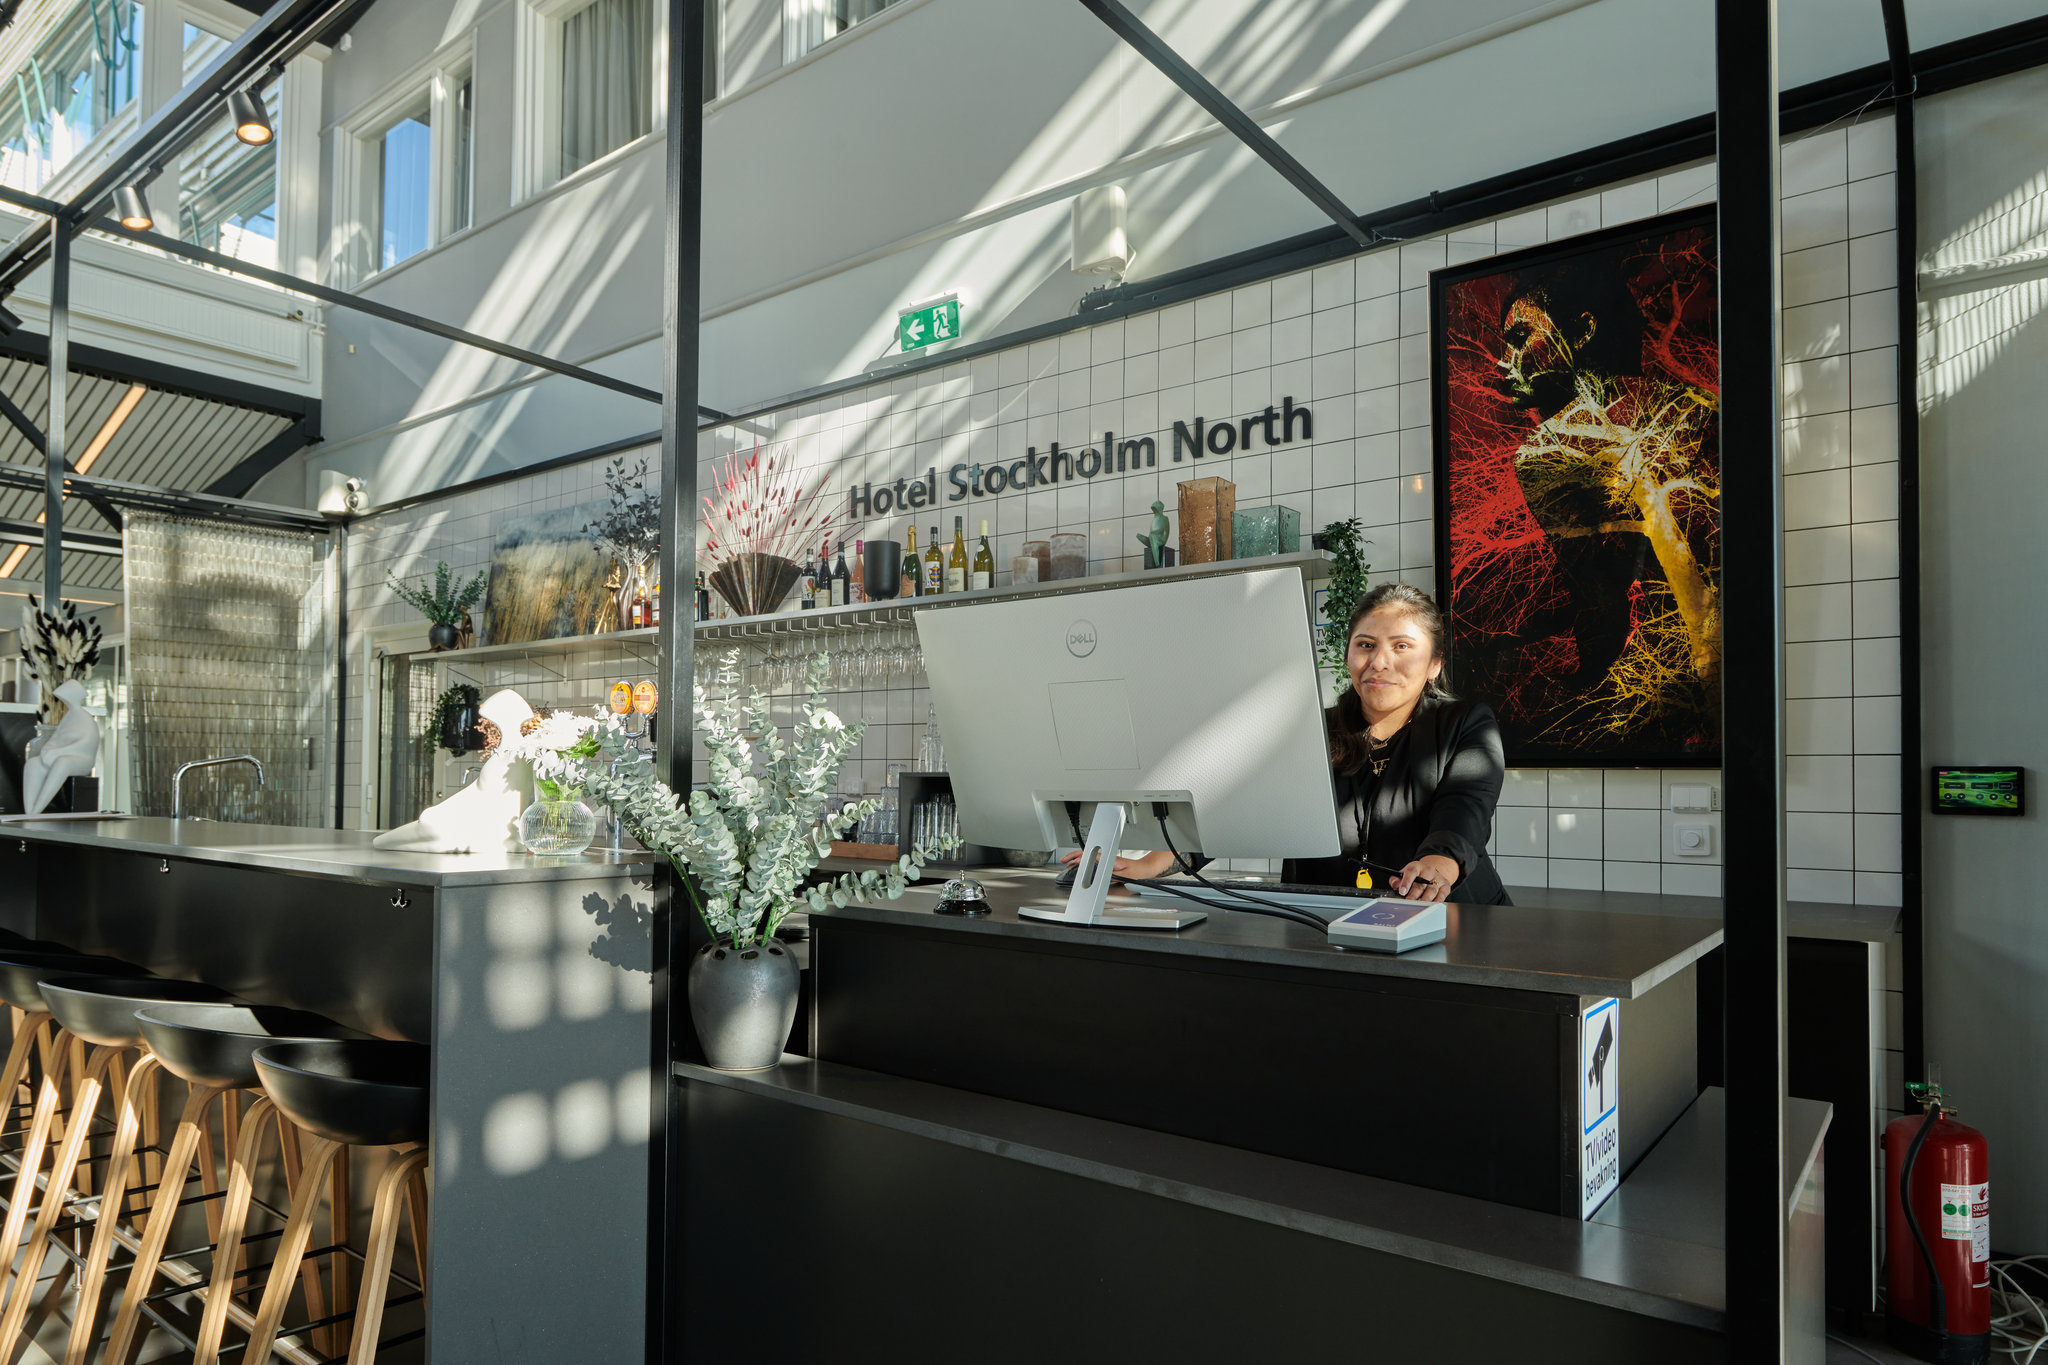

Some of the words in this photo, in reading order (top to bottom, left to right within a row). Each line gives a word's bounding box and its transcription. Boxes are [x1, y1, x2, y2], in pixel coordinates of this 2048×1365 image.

[850, 467, 936, 519] Hotel
[948, 431, 1156, 502] Stockholm
[1172, 396, 1313, 463] North
[1069, 633, 1094, 645] DELL
[1585, 1127, 1616, 1171] TV/video
[1585, 1157, 1616, 1202] bevakning
